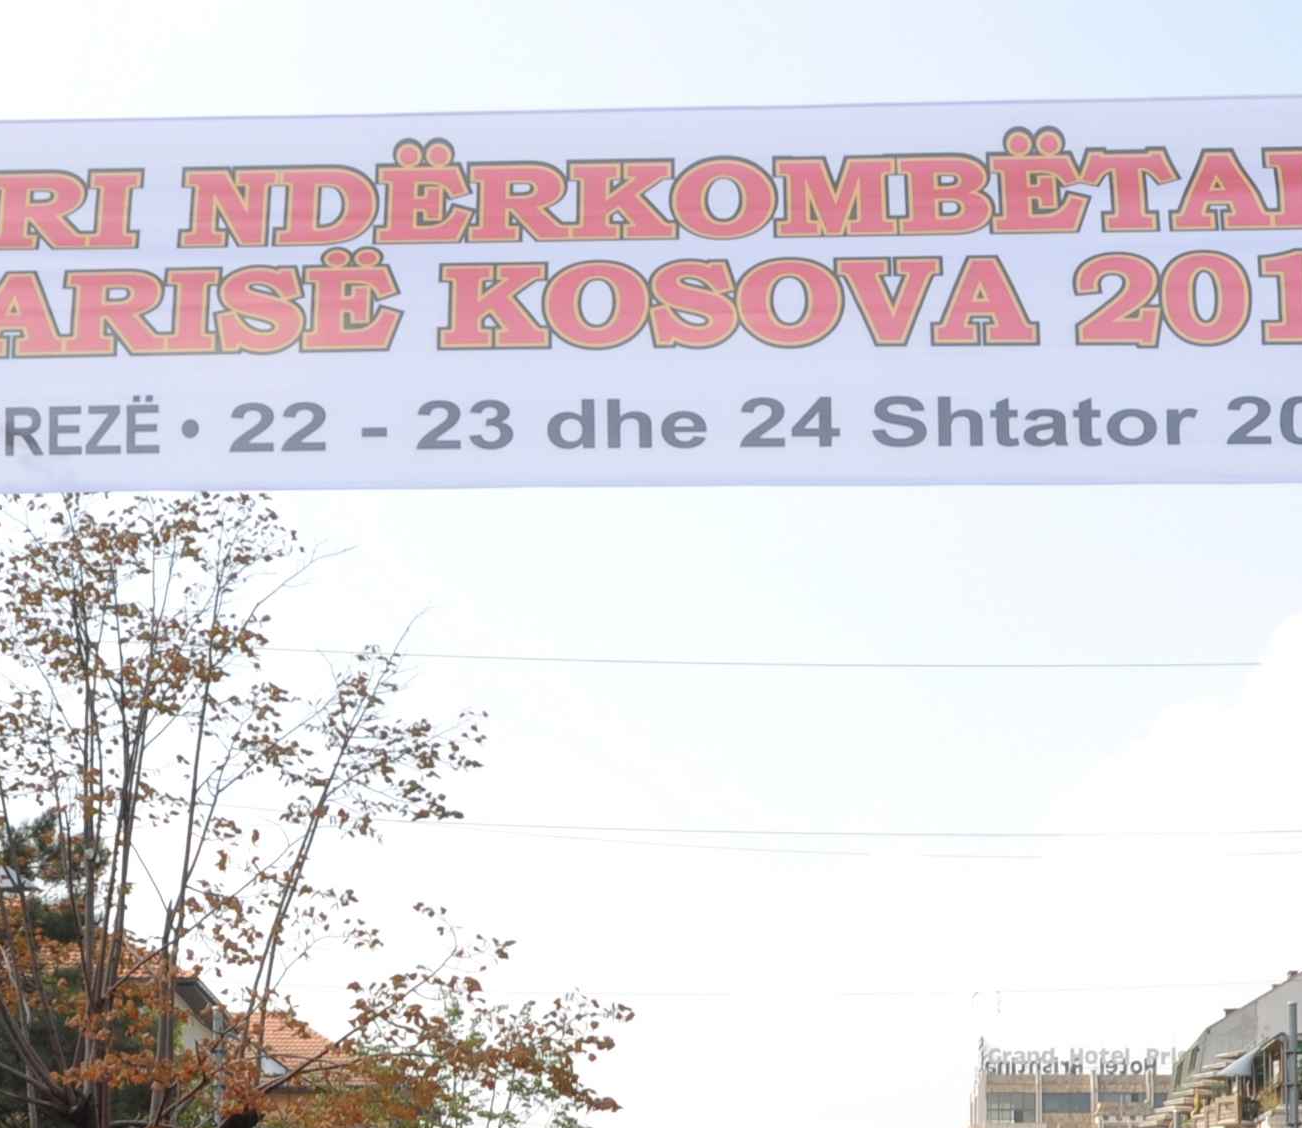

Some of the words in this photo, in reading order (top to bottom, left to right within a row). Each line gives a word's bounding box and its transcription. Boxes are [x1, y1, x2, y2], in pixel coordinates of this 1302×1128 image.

[437, 256, 1040, 351] KOSOVA
[228, 401, 328, 454] 22
[416, 399, 515, 452] 23
[546, 398, 707, 451] dhe
[739, 395, 841, 450] 24
[871, 395, 1199, 450] Shtator
[988, 1047, 1056, 1065] Grand
[1069, 1047, 1131, 1065] Hotel
